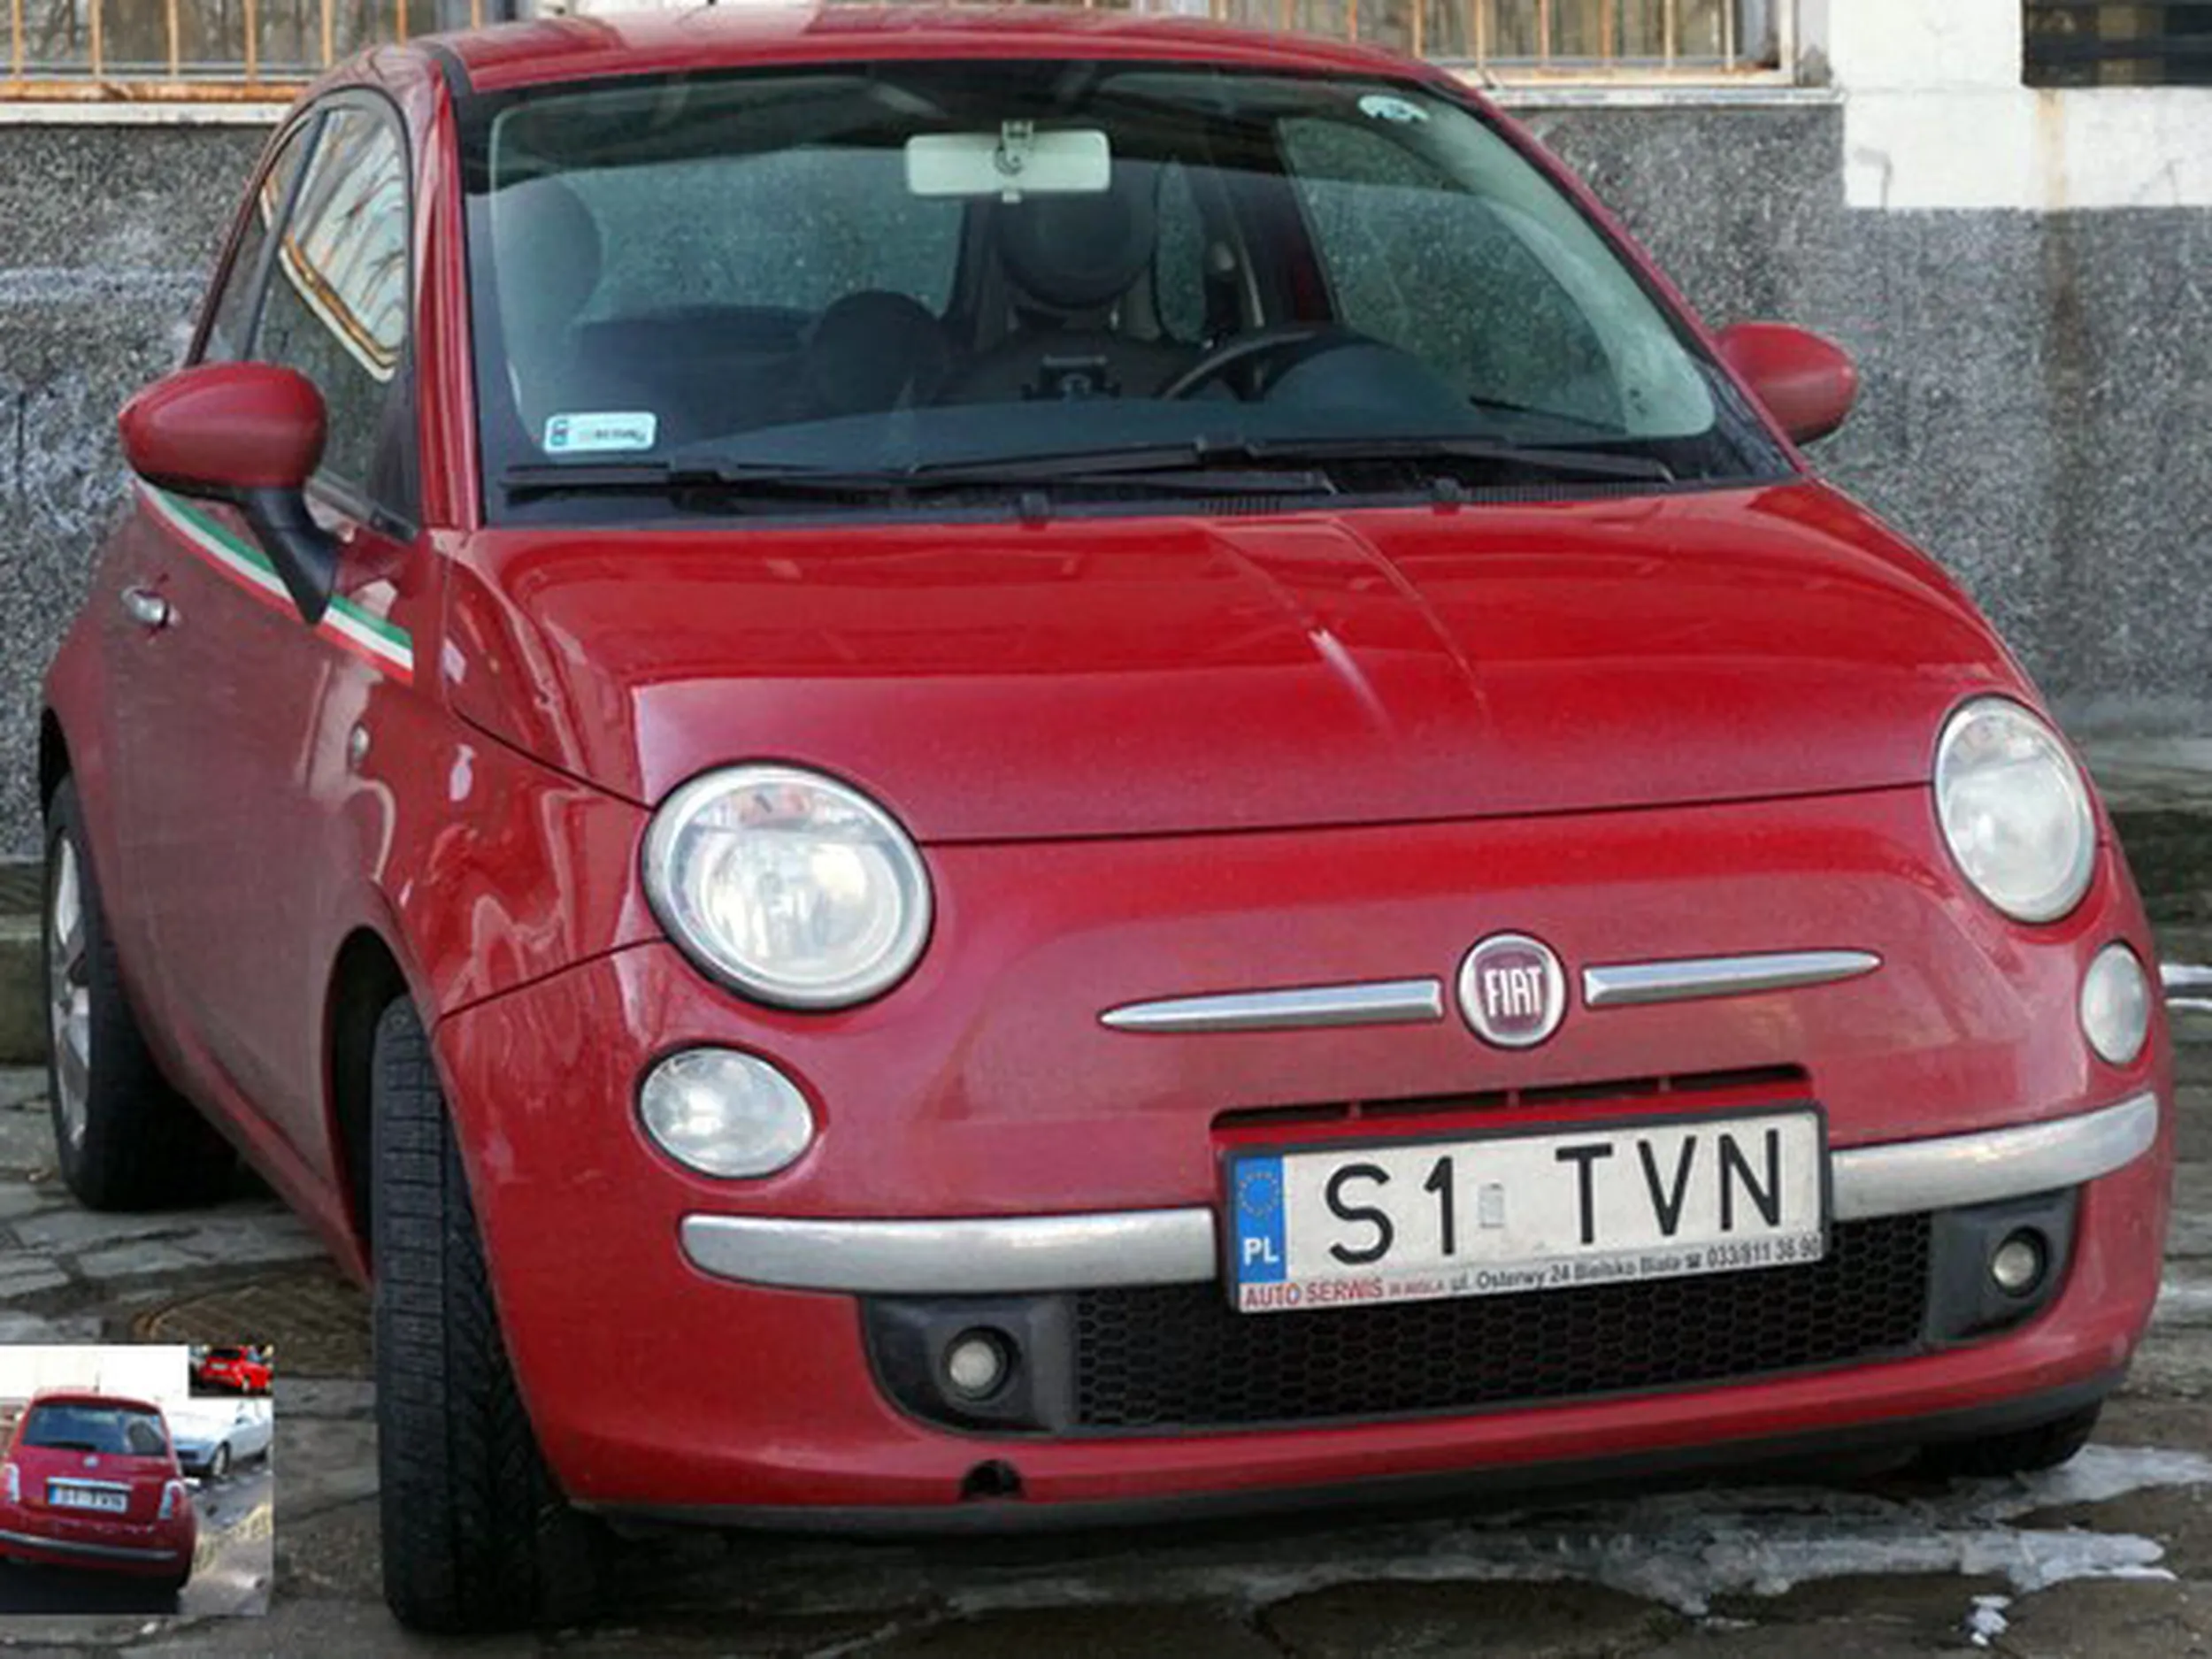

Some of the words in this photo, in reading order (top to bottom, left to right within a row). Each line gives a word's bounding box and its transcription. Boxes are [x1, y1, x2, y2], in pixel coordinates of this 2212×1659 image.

[1485, 965, 1540, 1018] FIAT
[1326, 1156, 1455, 1264] S1
[1555, 1128, 1780, 1245] TVN
[1243, 1236, 1279, 1266] PL
[1245, 1282, 1301, 1309] AUTO
[1305, 1276, 1384, 1304] SERWIS
[1550, 1263, 1570, 1283] 24
